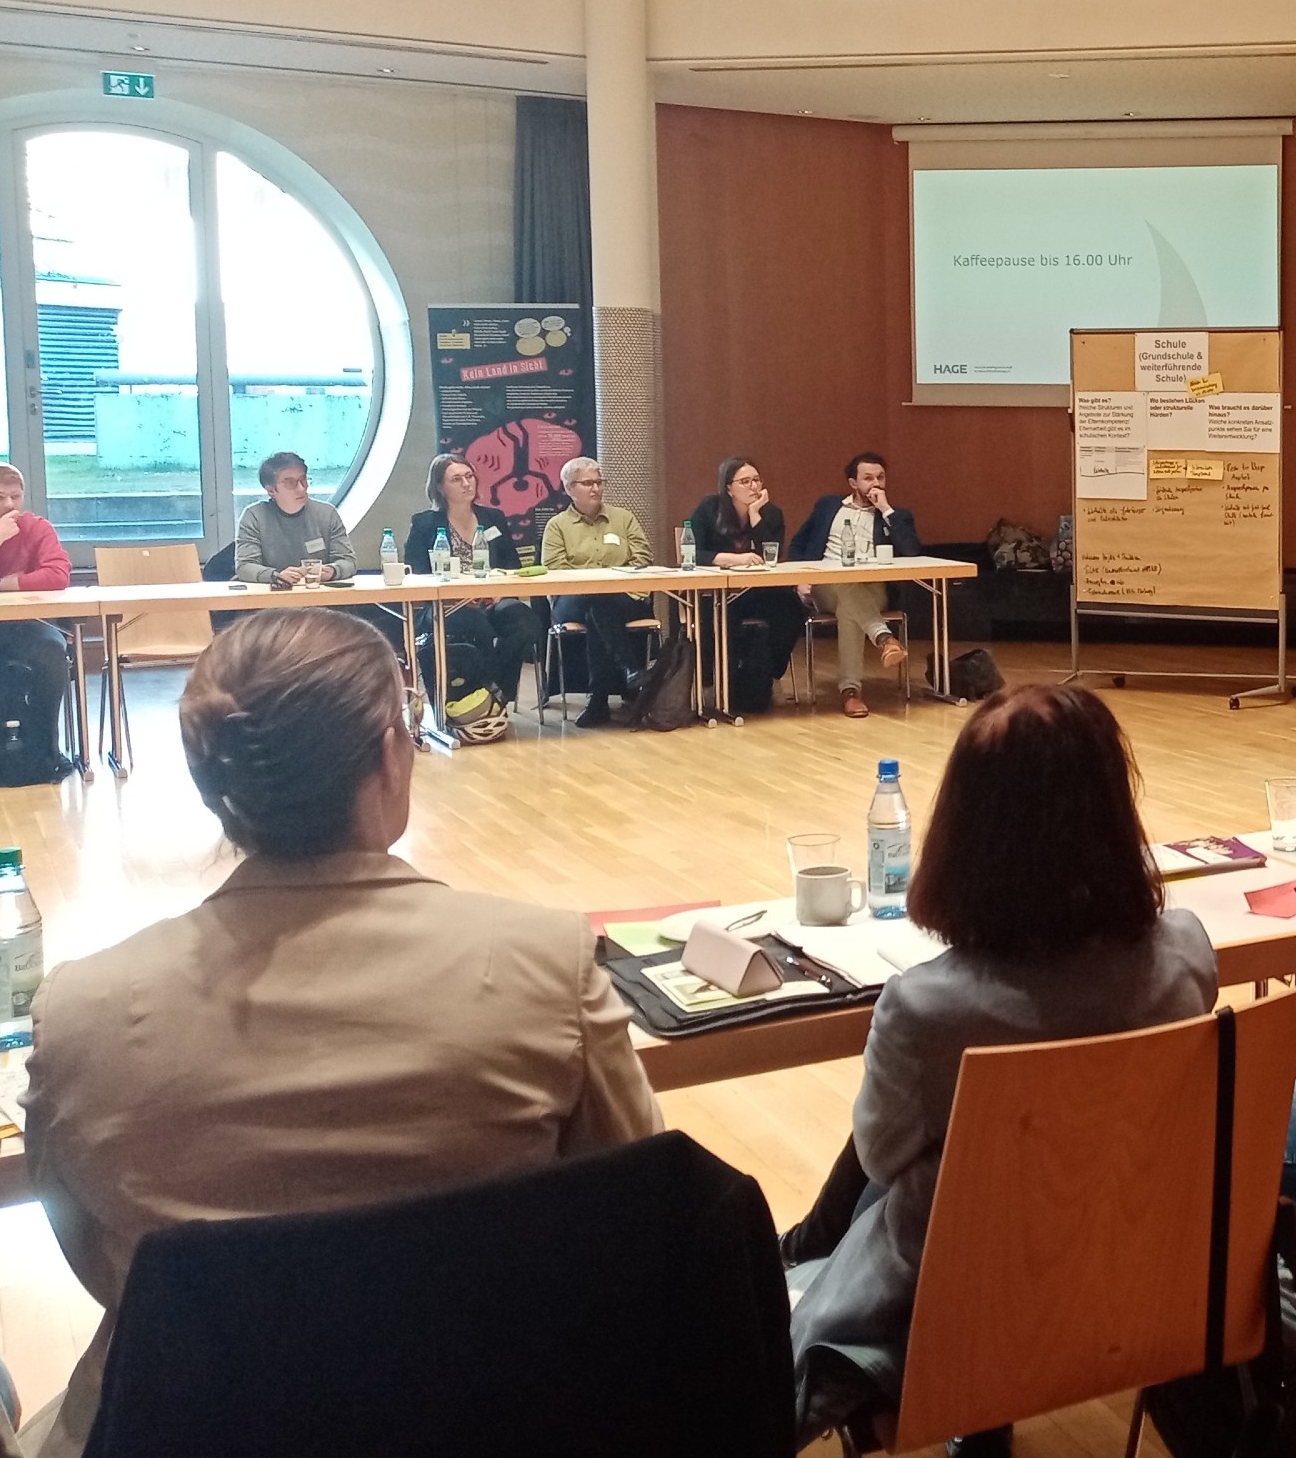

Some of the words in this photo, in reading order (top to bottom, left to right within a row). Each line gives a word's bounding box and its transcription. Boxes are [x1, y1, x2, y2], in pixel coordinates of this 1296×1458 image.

[953, 254, 1036, 268] Kaffeepause
[1040, 254, 1059, 266] bis
[1065, 254, 1103, 266] 16.00
[1108, 254, 1133, 266] Uhr
[1154, 339, 1187, 349] Schule
[1138, 352, 1194, 361] (Grundschule
[1197, 352, 1203, 360] &
[933, 364, 968, 374] HAGE
[1140, 363, 1202, 371] weiterführende
[1155, 374, 1187, 383] Schule)
